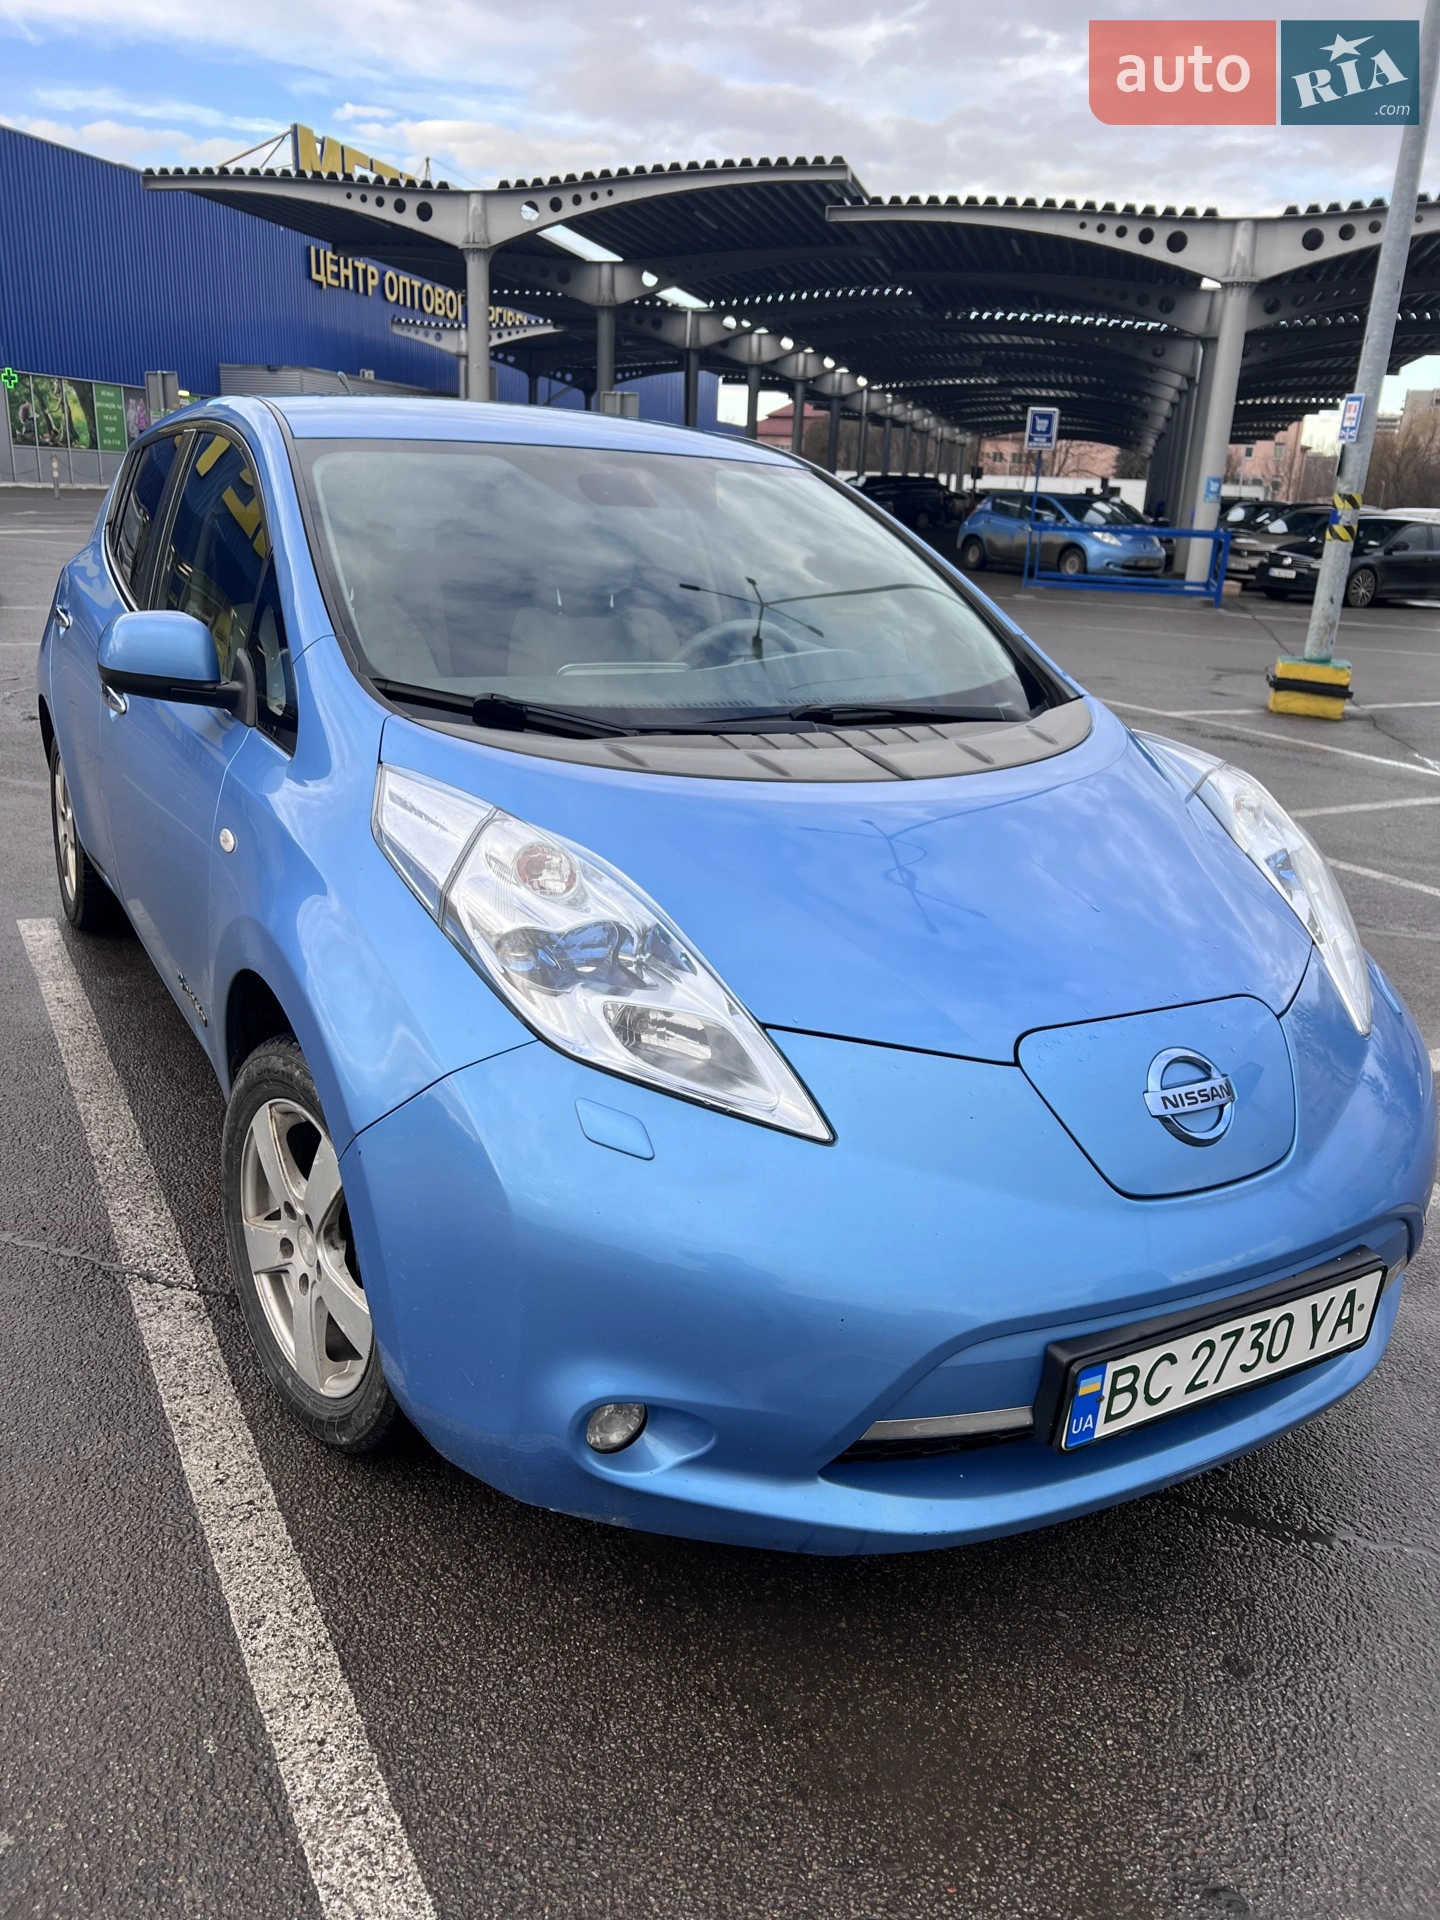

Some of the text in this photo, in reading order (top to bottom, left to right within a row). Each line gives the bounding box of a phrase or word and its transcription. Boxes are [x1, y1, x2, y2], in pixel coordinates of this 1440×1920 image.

[310, 245, 379, 297] ЦЕНТР
[1160, 1082, 1231, 1110] NISSAN
[1070, 1287, 1357, 1435] UA BC 2730 YA
